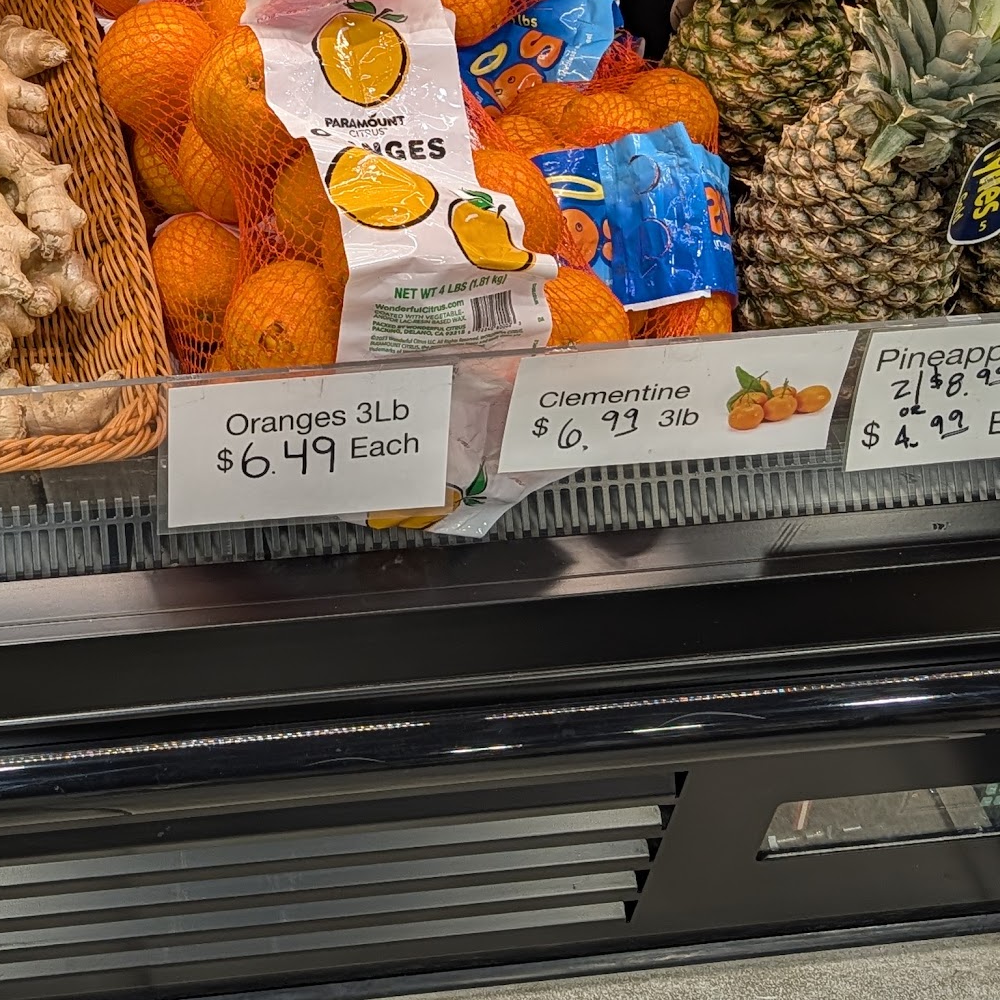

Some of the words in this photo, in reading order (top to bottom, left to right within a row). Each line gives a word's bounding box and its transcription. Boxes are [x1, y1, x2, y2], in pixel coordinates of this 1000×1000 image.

[517, 14, 538, 28] lbs
[324, 114, 405, 129] PARAMOUNT
[394, 287, 418, 300] NET
[420, 287, 438, 300] WT
[438, 284, 446, 296] 4
[448, 281, 468, 294] LBS
[491, 273, 508, 286] kg)
[375, 300, 465, 314] WonderfulCitrus.com
[445, 324, 466, 332] CITRUS
[539, 383, 691, 409] Clementine
[226, 407, 347, 436] Oranges
[356, 399, 410, 425] 3Lb
[658, 408, 700, 427] 3lb
[217, 435, 336, 479] $6.49
[351, 433, 419, 460] Each
